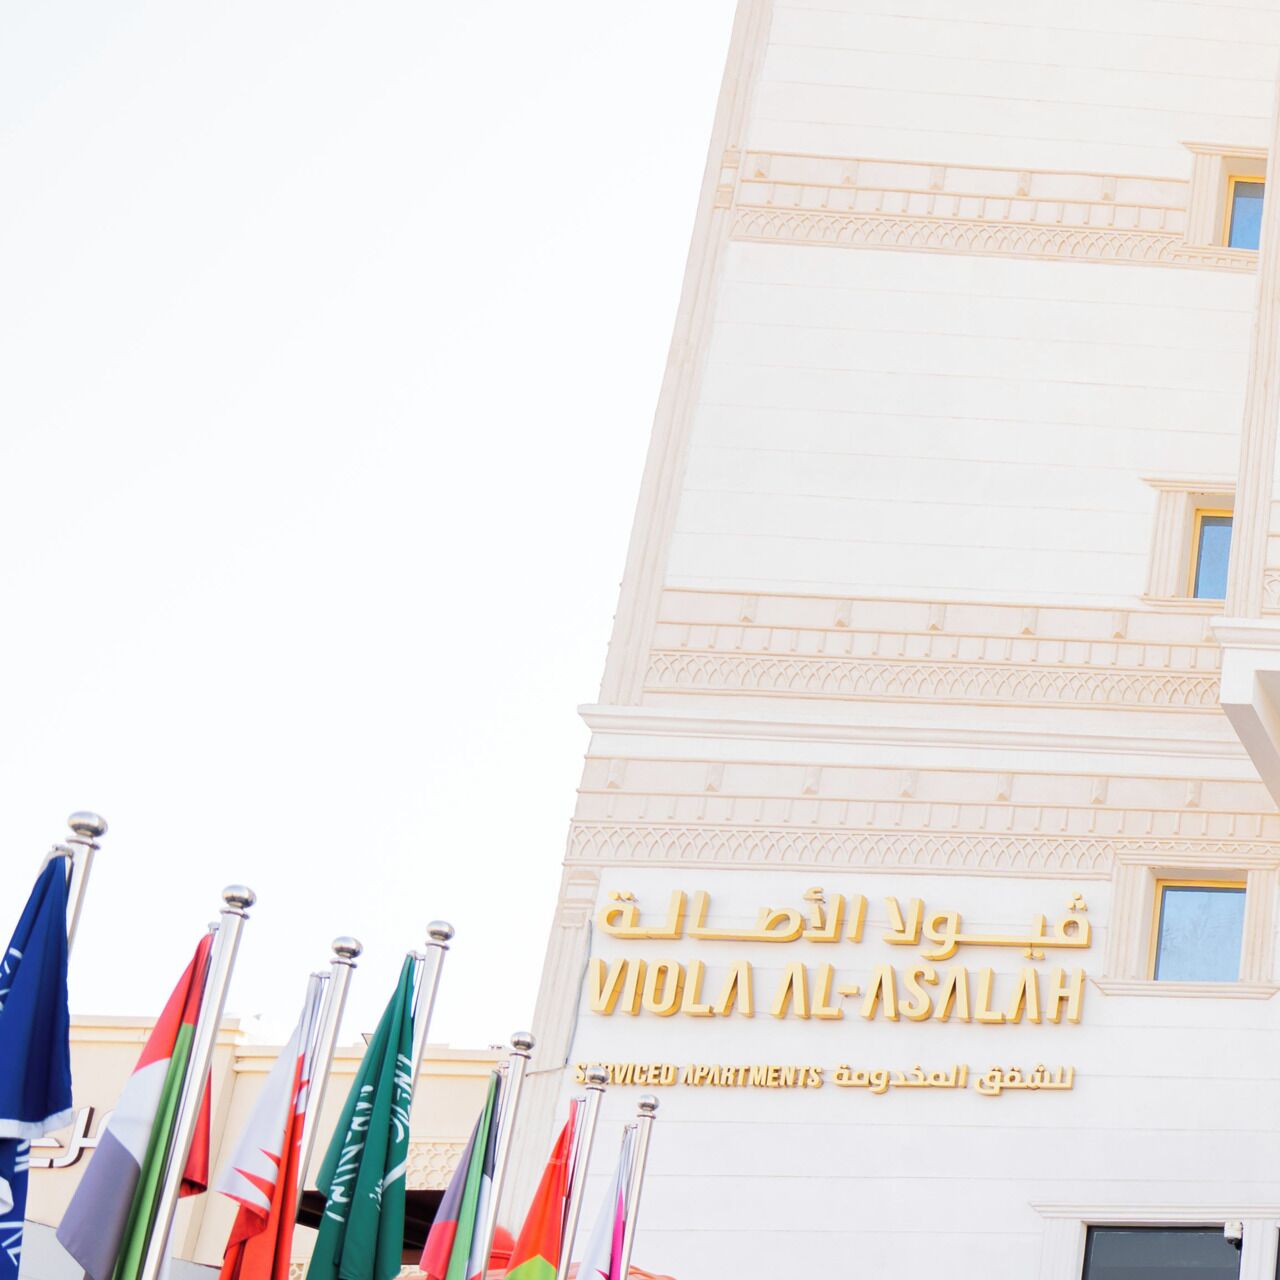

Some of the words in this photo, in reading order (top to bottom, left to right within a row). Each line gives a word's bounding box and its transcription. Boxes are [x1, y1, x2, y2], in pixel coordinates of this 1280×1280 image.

[597, 886, 868, 943] الأصالة
[588, 958, 754, 1018] VIOLA
[770, 960, 1086, 1024] AL-ASALAH
[575, 1062, 678, 1087] SRVICED
[683, 1063, 825, 1090] APARTMENTS
[832, 1063, 969, 1094] المخدومة
[975, 1063, 1076, 1096] للشقق
